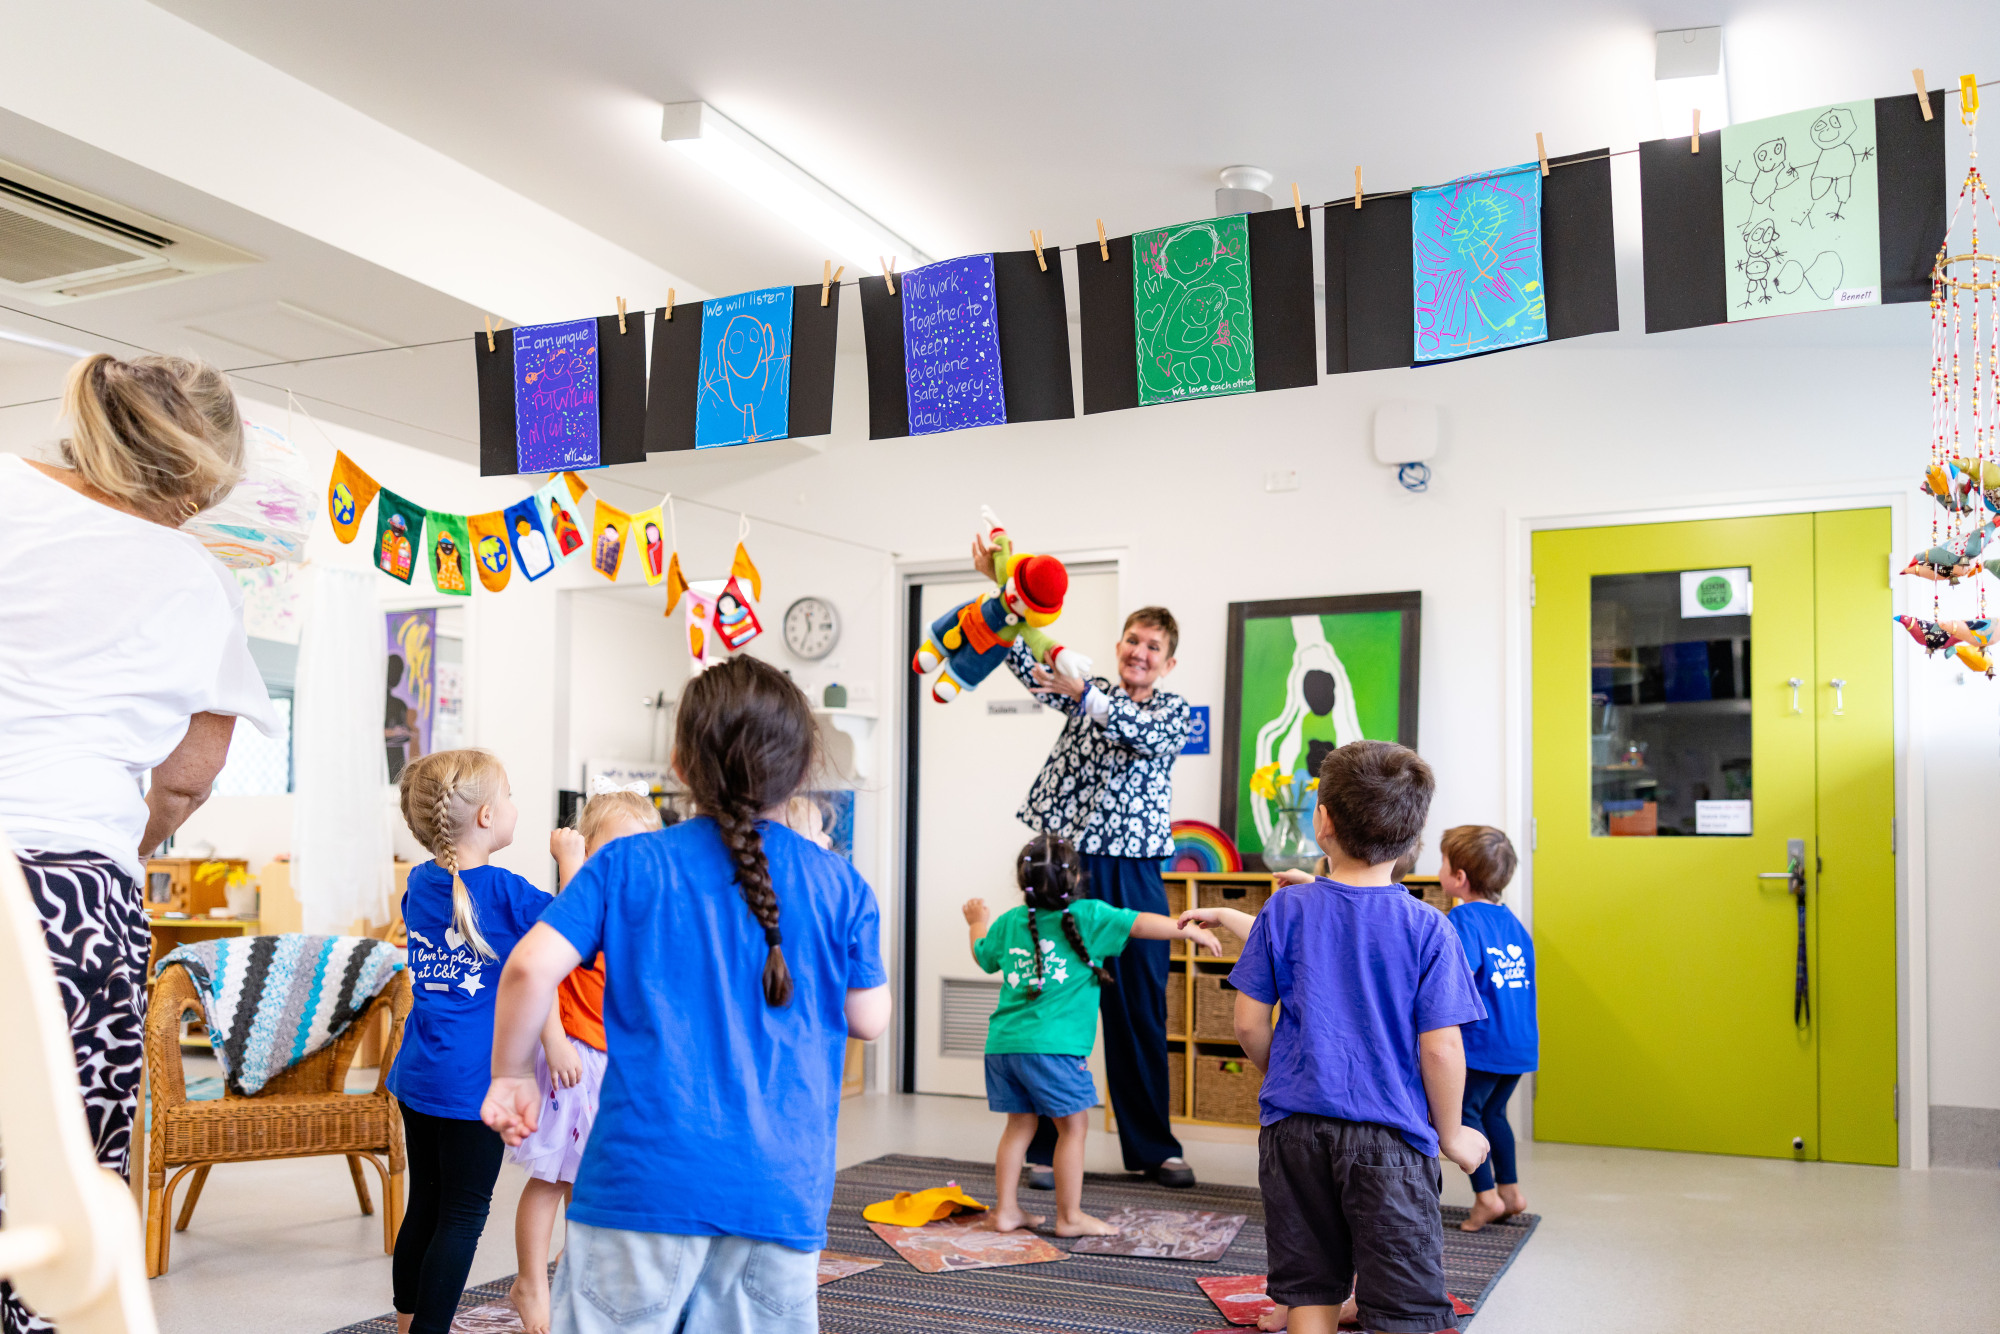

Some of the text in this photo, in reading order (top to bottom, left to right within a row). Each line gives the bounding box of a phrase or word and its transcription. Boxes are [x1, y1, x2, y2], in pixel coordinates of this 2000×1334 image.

[909, 272, 960, 301] We work
[1841, 291, 1872, 301] Bennett
[706, 291, 785, 317] We will listen
[909, 296, 983, 338] together to
[516, 335, 531, 351] I
[533, 336, 554, 349] am
[910, 356, 969, 384] everyone
[914, 378, 984, 403] safe every
[1172, 386, 1186, 396] We
[1188, 385, 1208, 394] love
[1210, 381, 1231, 391] each
[418, 948, 437, 962] love
[437, 946, 449, 960] to
[449, 950, 483, 973] play
[418, 963, 461, 980] at C&K
